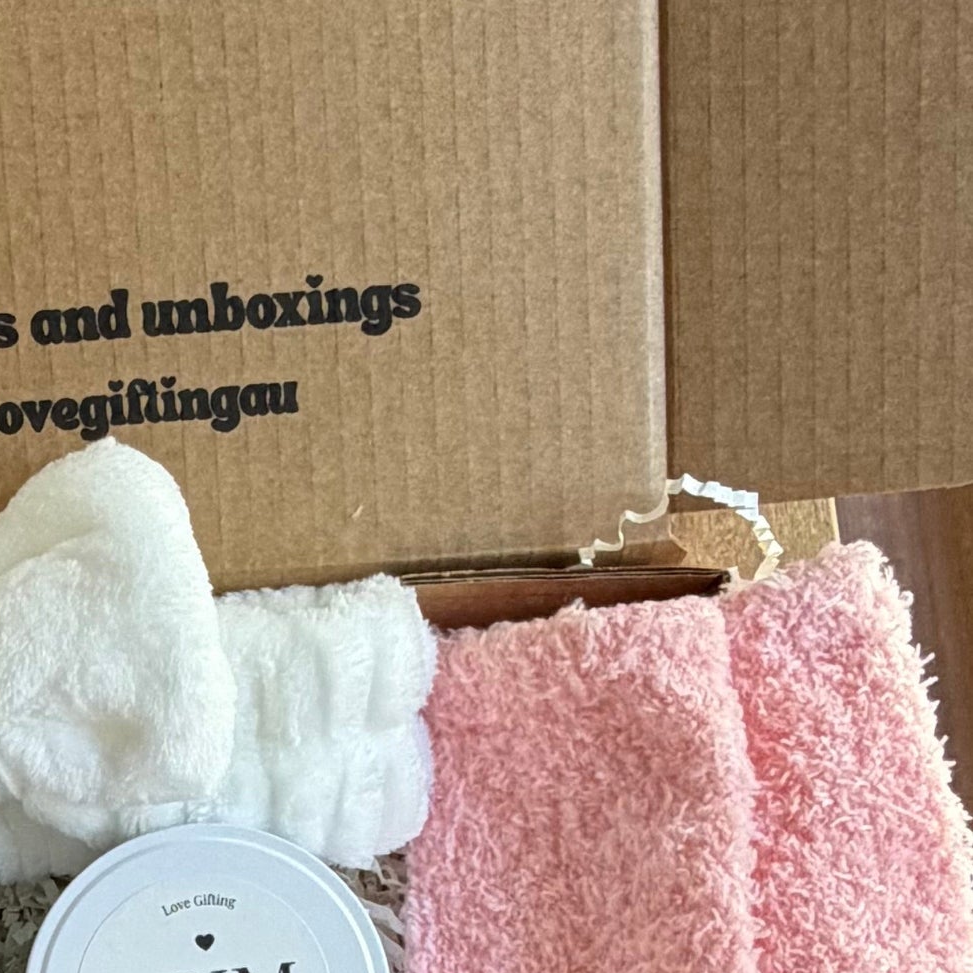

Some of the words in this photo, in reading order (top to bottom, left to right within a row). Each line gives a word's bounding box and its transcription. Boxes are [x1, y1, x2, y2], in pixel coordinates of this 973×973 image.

[30, 289, 132, 345] and
[141, 274, 421, 336] unboxings
[161, 897, 192, 917] Love
[193, 893, 237, 910] Gifting
